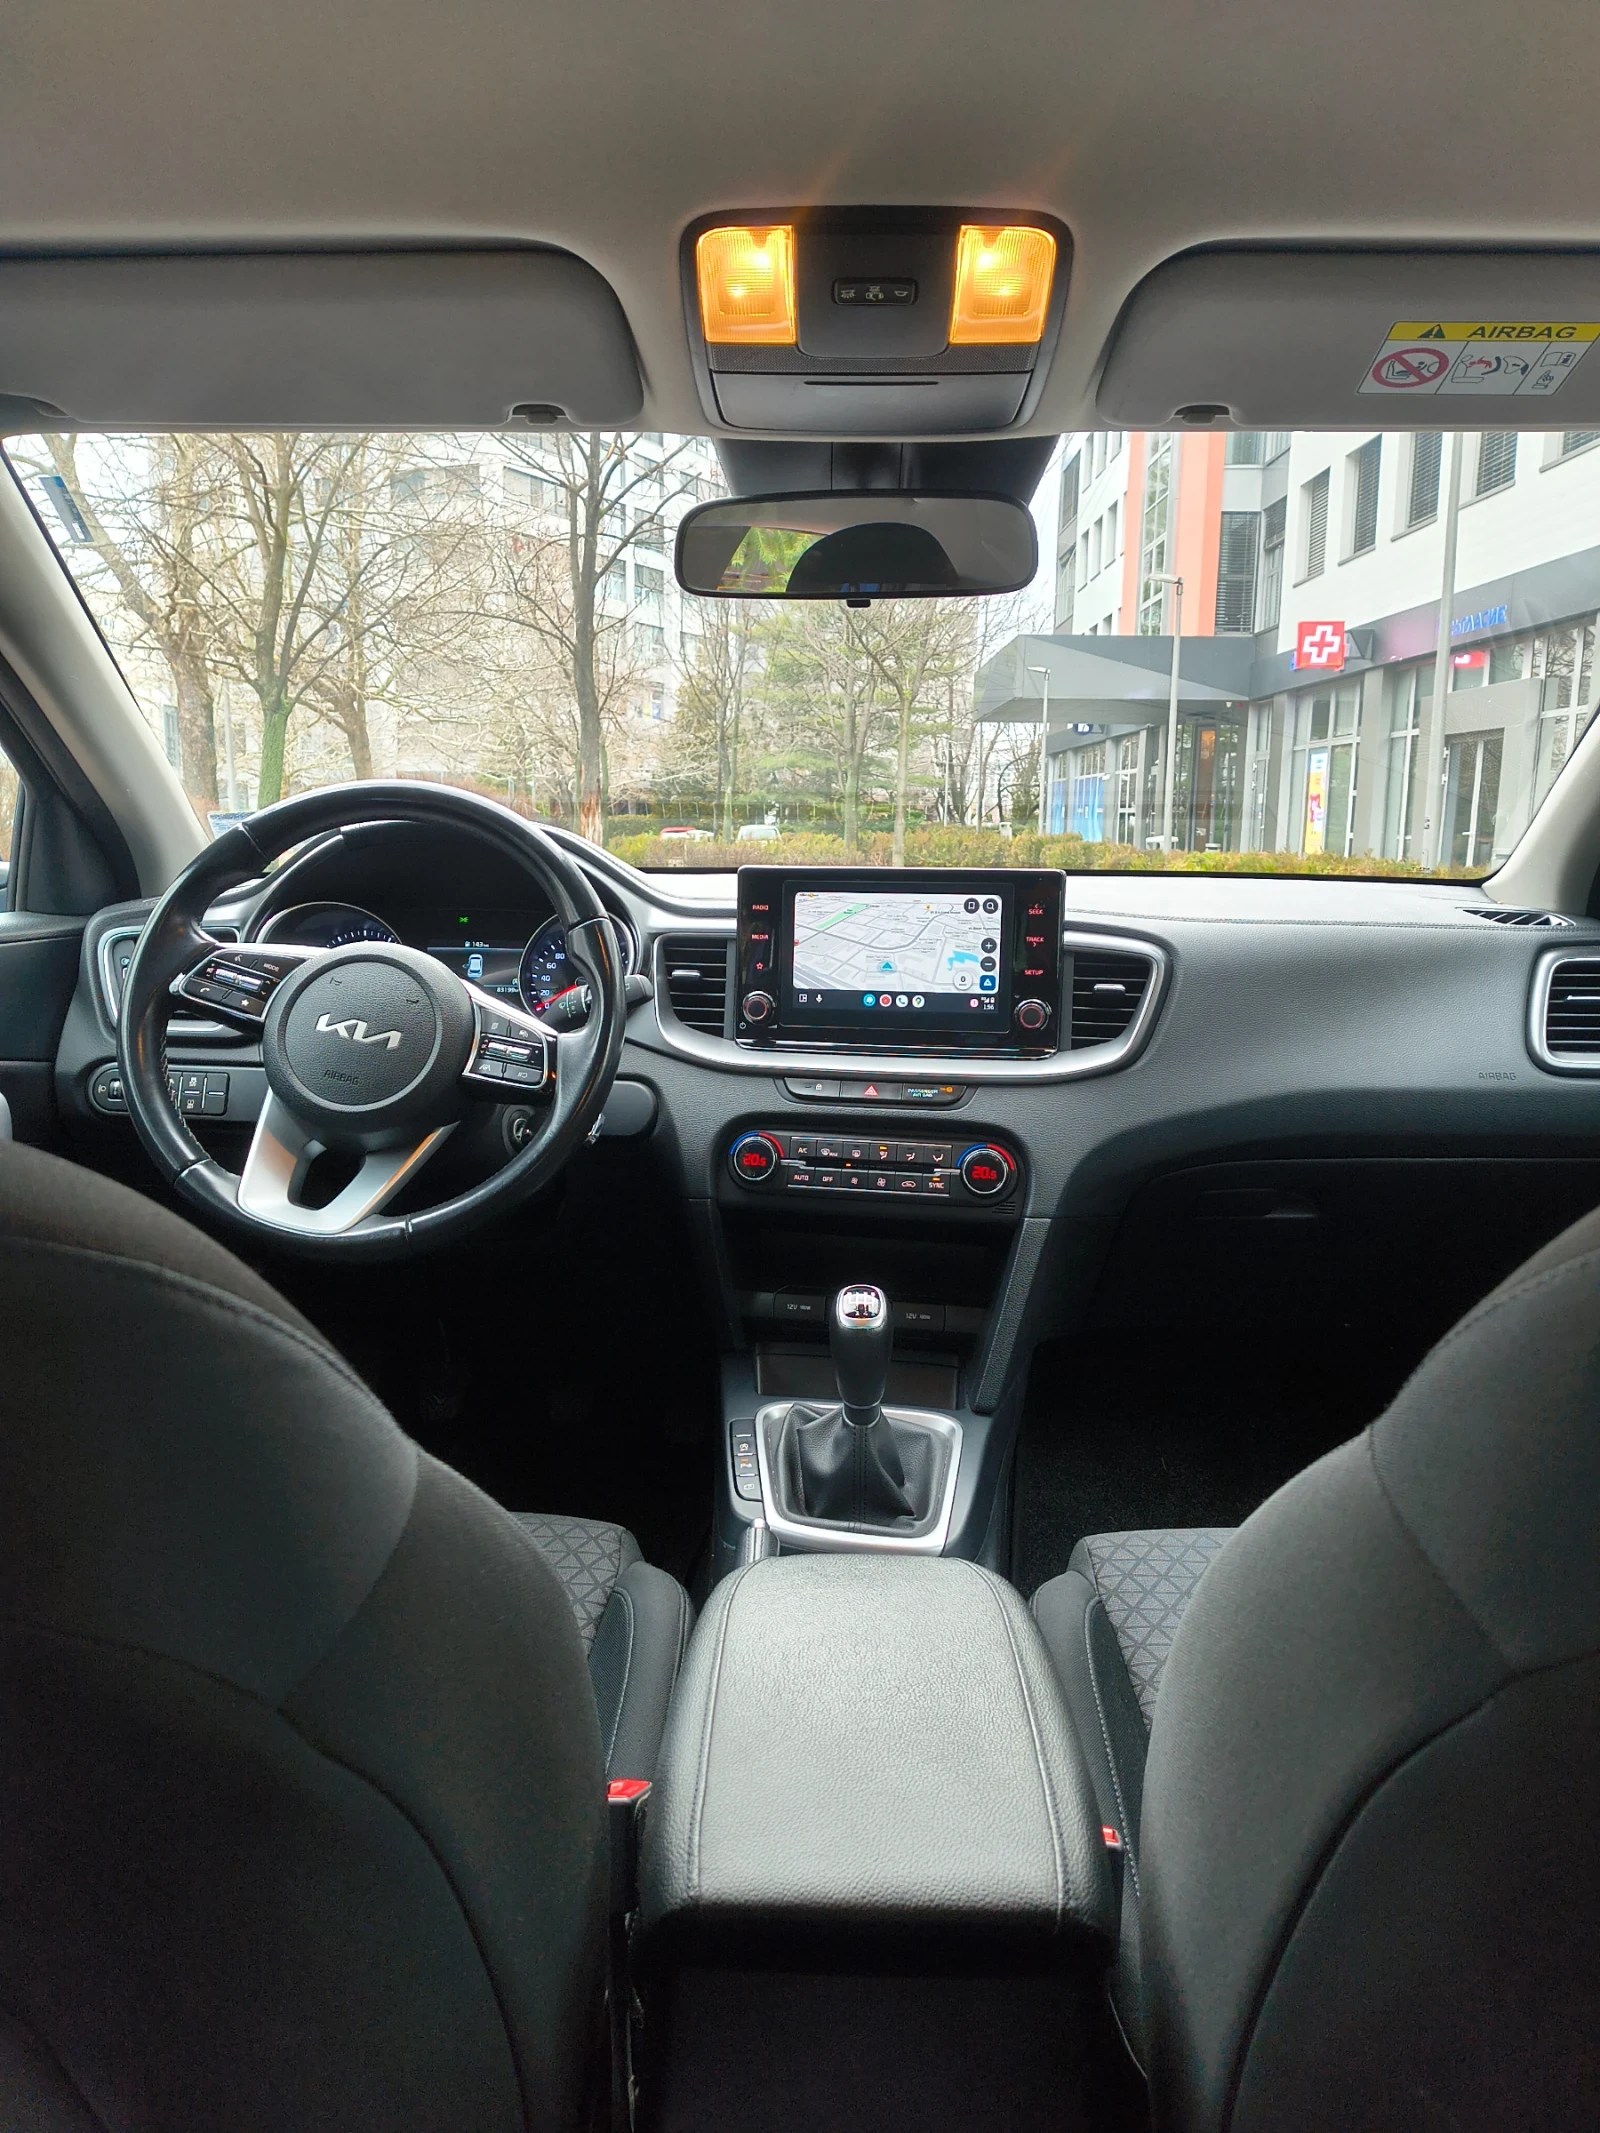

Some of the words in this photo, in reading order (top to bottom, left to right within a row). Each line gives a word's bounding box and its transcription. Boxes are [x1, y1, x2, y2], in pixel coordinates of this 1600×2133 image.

[1467, 326, 1577, 339] AIRBAG
[554, 952, 566, 960] 80
[263, 962, 280, 973] MODE
[322, 1069, 360, 1086] AIRBAG
[1478, 1072, 1516, 1081] AIRBAG
